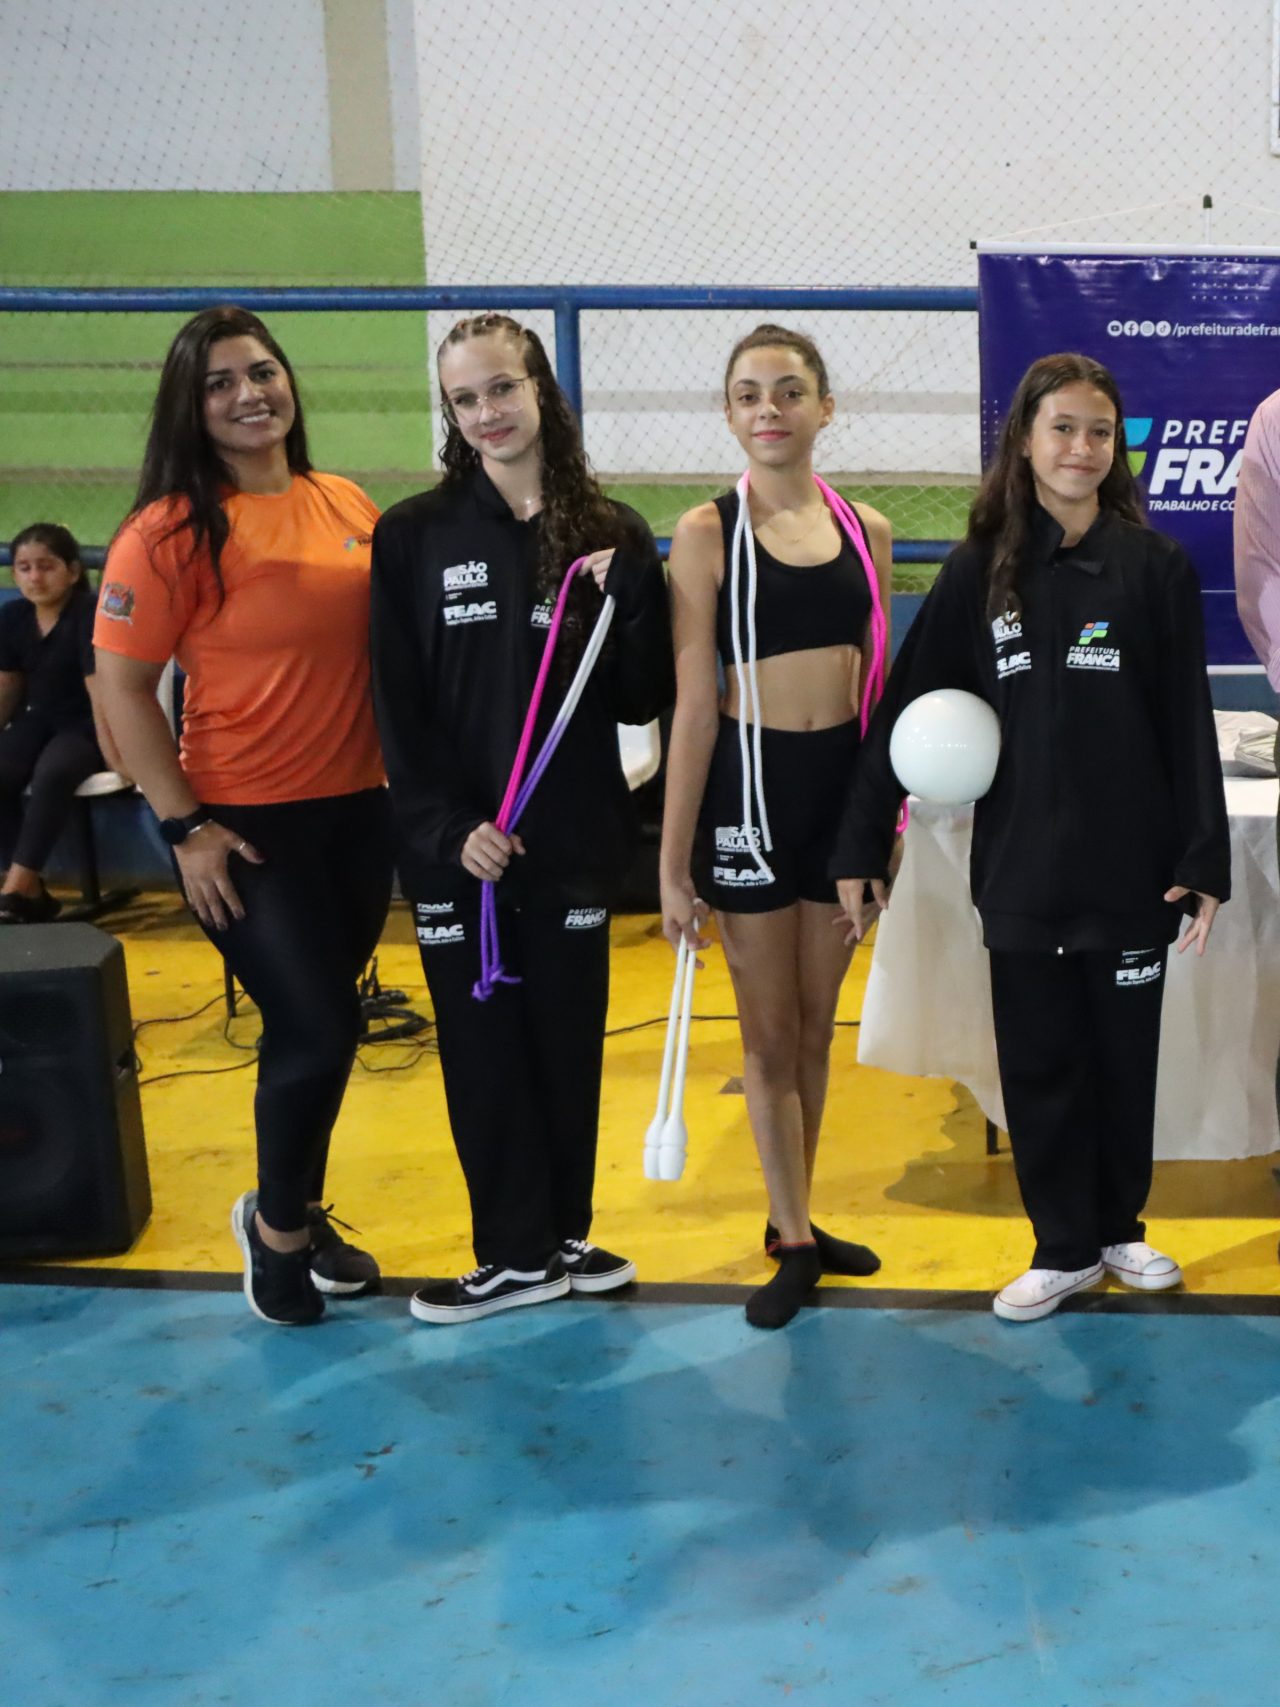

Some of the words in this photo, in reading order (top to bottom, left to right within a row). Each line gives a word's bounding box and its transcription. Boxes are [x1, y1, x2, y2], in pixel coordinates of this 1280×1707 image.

[1148, 500, 1211, 512] TRABALHO
[1211, 500, 1218, 511] E
[461, 561, 488, 574] SÃO
[443, 600, 497, 621] FEAC
[1065, 651, 1121, 668] FRANCA
